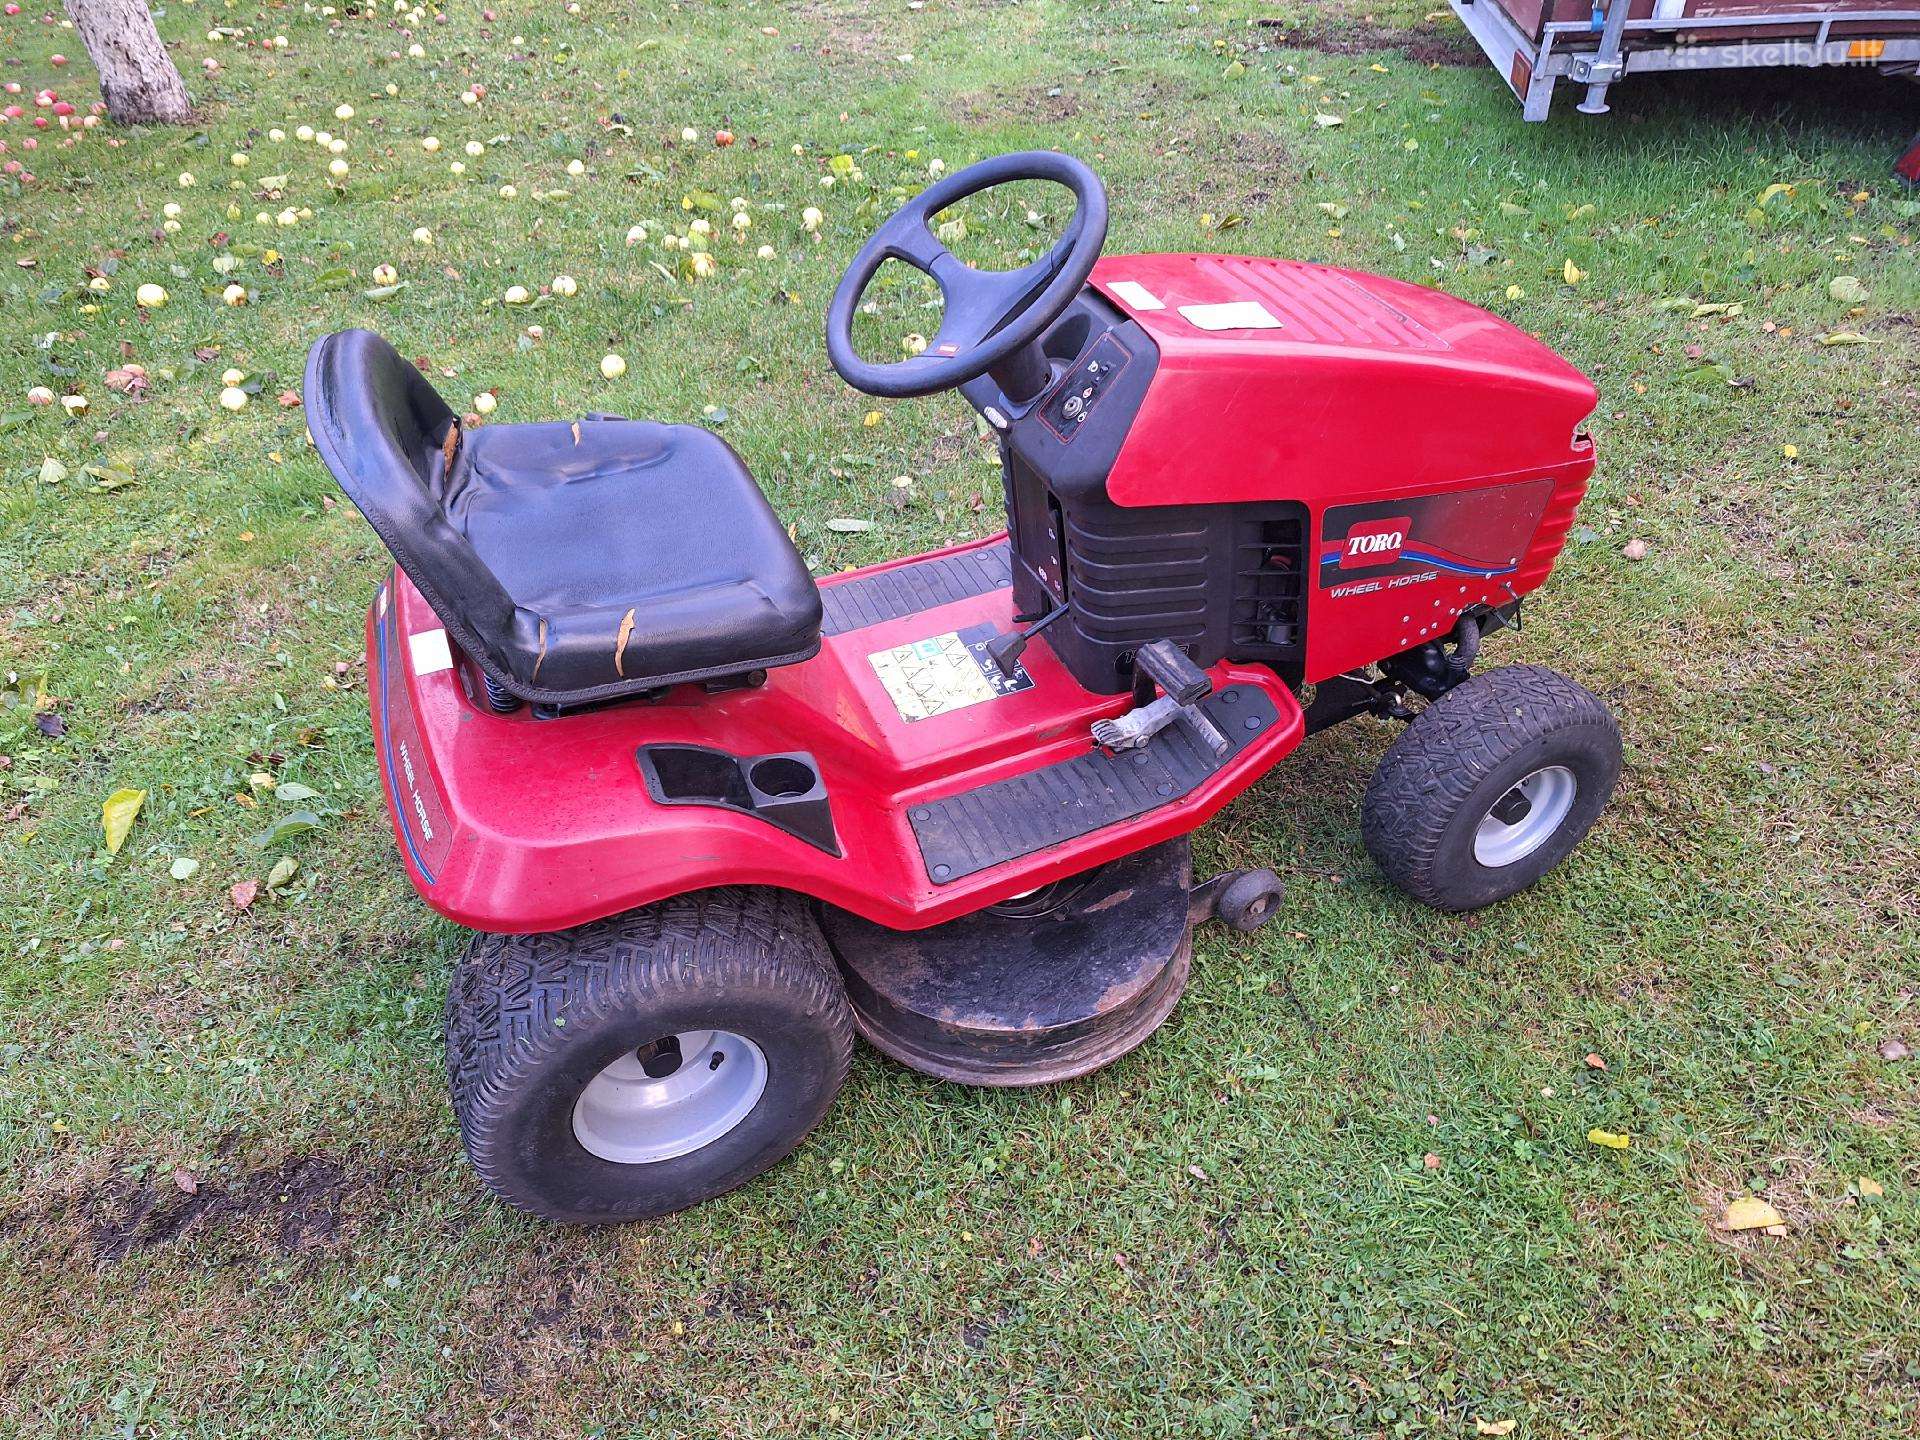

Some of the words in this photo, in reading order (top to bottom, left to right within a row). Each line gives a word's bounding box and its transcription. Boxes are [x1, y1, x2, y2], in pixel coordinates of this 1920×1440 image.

[1348, 532, 1402, 556] TORO
[1331, 582, 1383, 598] WHEEL
[1388, 571, 1438, 588] HORSE
[400, 740, 415, 791] WHEEL
[412, 789, 434, 842] HORSE
